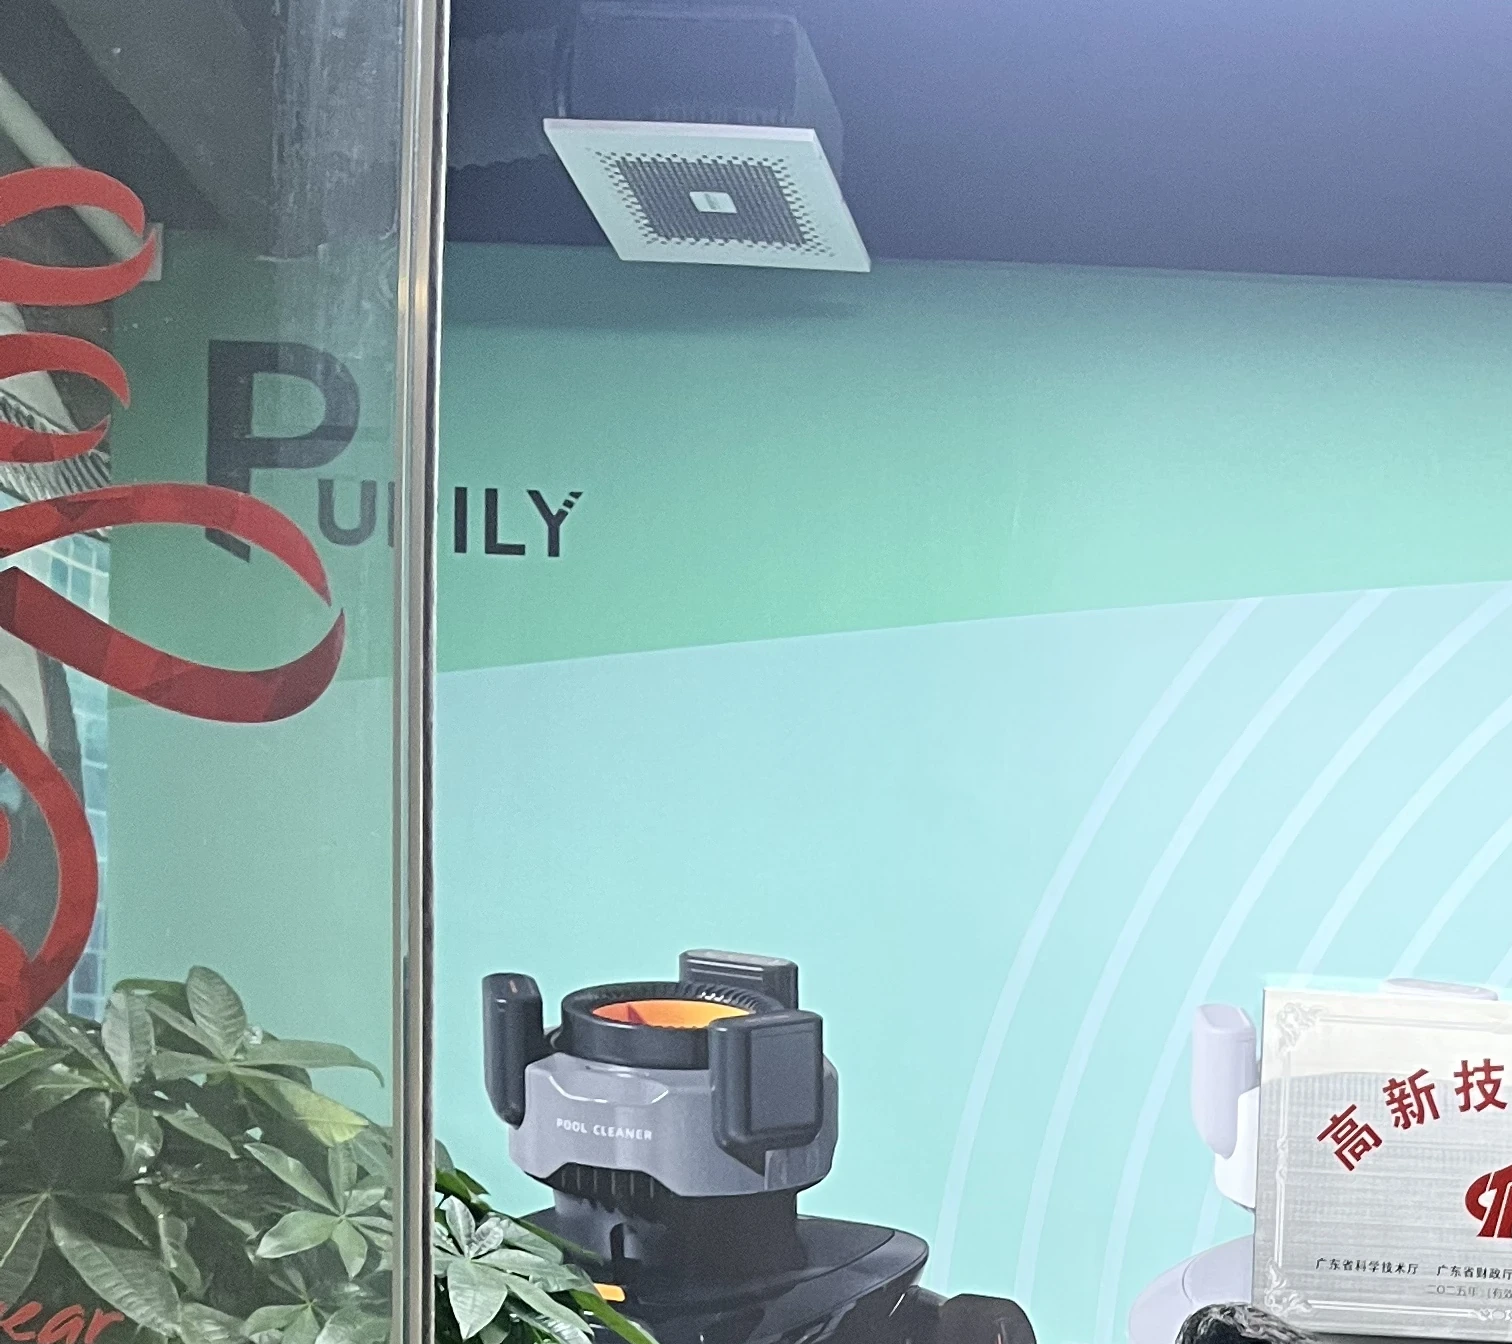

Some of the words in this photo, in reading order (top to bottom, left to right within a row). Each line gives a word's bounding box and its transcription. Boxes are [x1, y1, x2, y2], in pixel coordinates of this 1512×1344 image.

[205, 340, 584, 564] PUILY
[556, 1117, 588, 1134] POOL
[593, 1124, 653, 1140] CLEANER
[1315, 1257, 1419, 1275] 广东省科学技术厅
